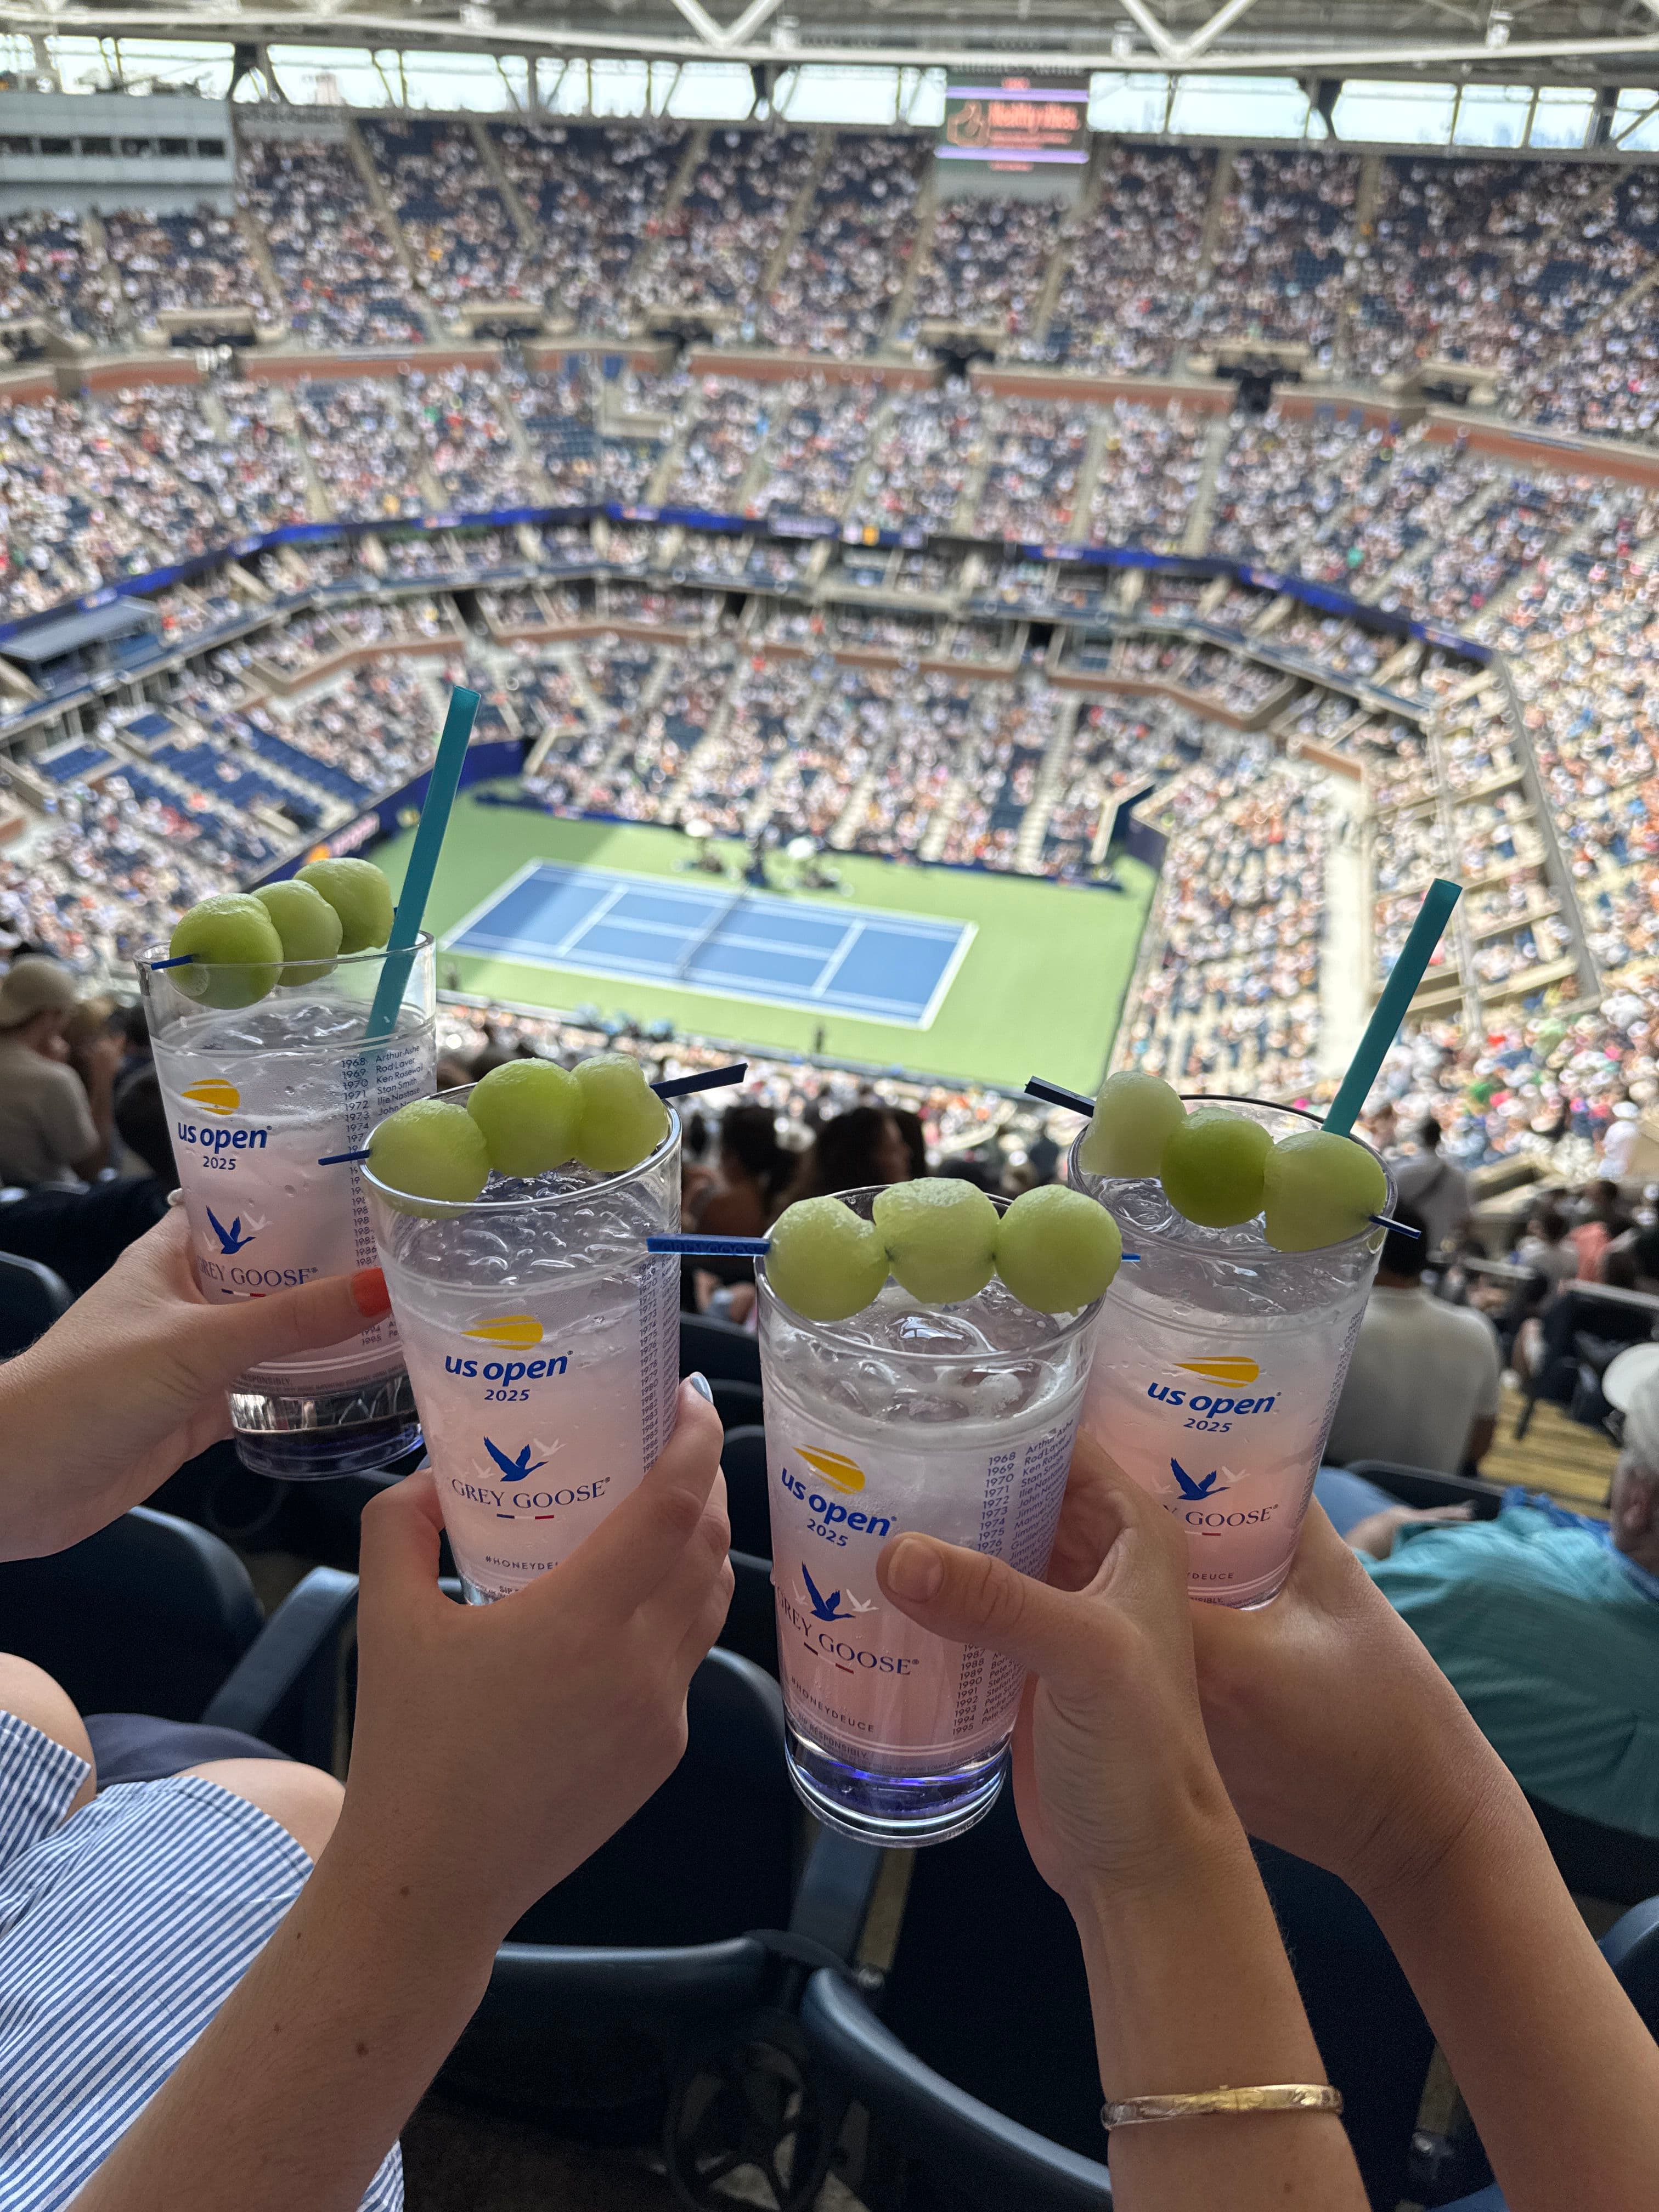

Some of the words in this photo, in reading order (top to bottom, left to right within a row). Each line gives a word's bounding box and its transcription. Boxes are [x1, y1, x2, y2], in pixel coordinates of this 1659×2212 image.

[342, 1058, 366, 1068] 1968
[376, 1051, 402, 1063] Arthur
[404, 1045, 420, 1054] Ashe
[342, 1069, 366, 1079] 1969
[376, 1063, 393, 1073] Rod
[395, 1058, 415, 1069] Laver
[343, 1079, 368, 1090] 1970
[377, 1075, 393, 1084] Ken
[344, 1091, 366, 1101] 1971
[377, 1085, 396, 1094] Stan
[398, 1078, 417, 1089] Smith
[345, 1101, 369, 1111] 1972
[392, 1087, 420, 1101] Nastase
[345, 1111, 369, 1122] 1973
[379, 1104, 399, 1115] John
[178, 1122, 196, 1143] us
[347, 1123, 369, 1132] 1974
[347, 1133, 364, 1143] 197
[203, 1156, 236, 1170] 2025
[353, 1206, 368, 1216] 198
[354, 1217, 369, 1226] 198
[356, 1246, 376, 1256] 1986
[357, 1255, 377, 1267] 1987
[639, 1290, 655, 1306] 1971
[640, 1299, 656, 1316] 1972
[639, 1310, 656, 1326] 1973
[640, 1321, 656, 1336] 1974
[640, 1329, 657, 1346] 1975
[640, 1340, 656, 1356] 1976
[445, 1355, 477, 1378] us
[640, 1350, 657, 1366] 1977
[641, 1360, 657, 1376] 1978
[641, 1369, 658, 1386] 1979
[484, 1389, 530, 1401] 2025
[641, 1379, 658, 1395] 1980
[1148, 1382, 1186, 1406] us
[641, 1390, 656, 1406] 1981
[641, 1399, 658, 1416] 1982
[641, 1409, 658, 1426] 1983
[1183, 1418, 1232, 1433] 2025
[642, 1418, 658, 1435] 1984
[642, 1427, 658, 1444] 1985
[643, 1438, 658, 1454] 1986
[643, 1446, 658, 1463] 1987
[989, 1452, 1015, 1466] 1968
[1026, 1436, 1054, 1455] Arthur
[988, 1463, 1014, 1476] 1969
[1025, 1449, 1043, 1466] Rod
[1045, 1435, 1066, 1455] Laver
[781, 1467, 806, 1500] us
[986, 1474, 1014, 1488] 1970
[1023, 1464, 1040, 1476] Ken
[452, 1479, 505, 1506] GREY
[984, 1485, 1009, 1498] 1971
[1022, 1472, 1042, 1487] Stan
[982, 1506, 1008, 1520] 1973
[1018, 1493, 1040, 1509] John
[983, 1496, 1009, 1509] 1972
[1019, 1487, 1032, 1498] Ilie
[980, 1518, 1005, 1531] 1974
[1016, 1501, 1042, 1520] Jimmy
[807, 1518, 848, 1547] 2025
[978, 1539, 1002, 1551] 1976
[1013, 1521, 1040, 1540] Jimmy
[979, 1527, 1005, 1541] 1975
[486, 1555, 558, 1570] #HONEYDE
[963, 1649, 985, 1661] 1987
[962, 1658, 984, 1671] 1988
[960, 1677, 982, 1689] 1990
[990, 1665, 1007, 1679] Pete
[961, 1668, 983, 1680] 1989
[957, 1696, 978, 1708] 1992
[958, 1688, 977, 1699] 1991
[792, 1676, 874, 1732] #HONEYDEUCE
[956, 1706, 977, 1717] 1993
[985, 1693, 1002, 1707] Pete
[953, 1723, 974, 1735] 1995
[982, 1712, 998, 1724] Pete
[954, 1715, 974, 1726] 1994
